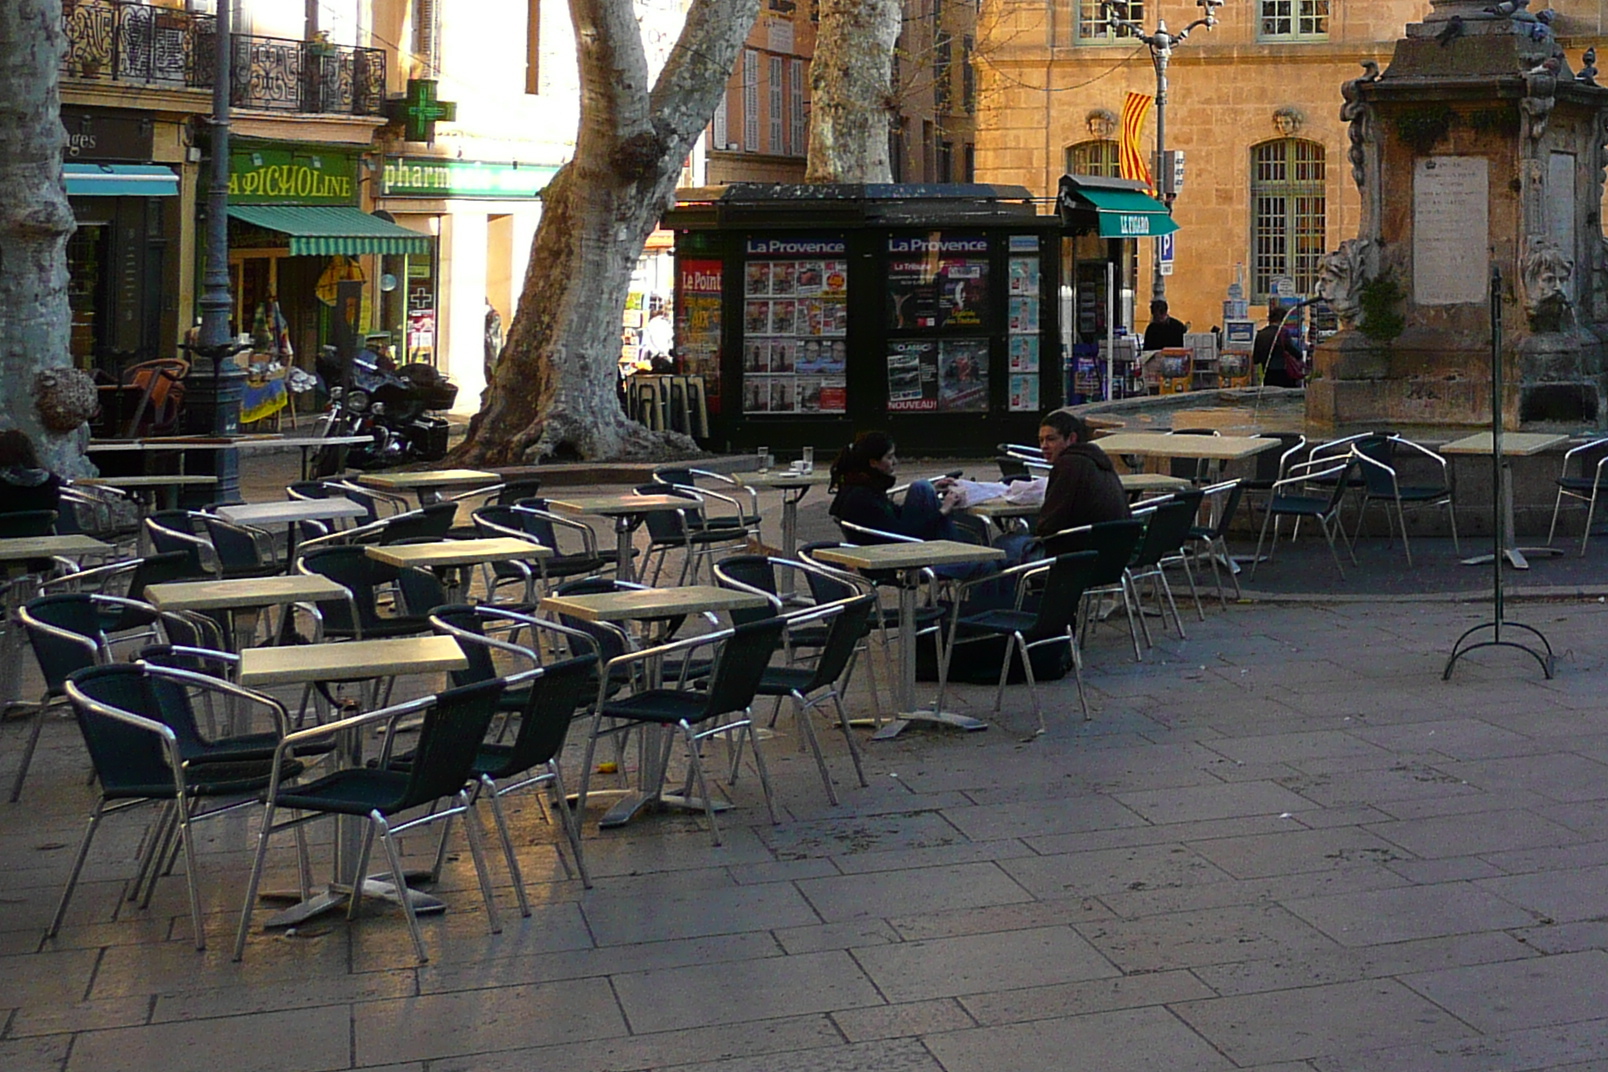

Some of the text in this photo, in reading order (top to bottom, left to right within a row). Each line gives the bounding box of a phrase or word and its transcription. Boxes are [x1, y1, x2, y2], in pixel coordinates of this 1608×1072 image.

[243, 165, 351, 197] PICHOLINE
[747, 240, 845, 253] La Provence
[888, 239, 988, 252] La Provence
[682, 270, 721, 290] Le Point
[887, 400, 937, 411] NOUVEAU!
